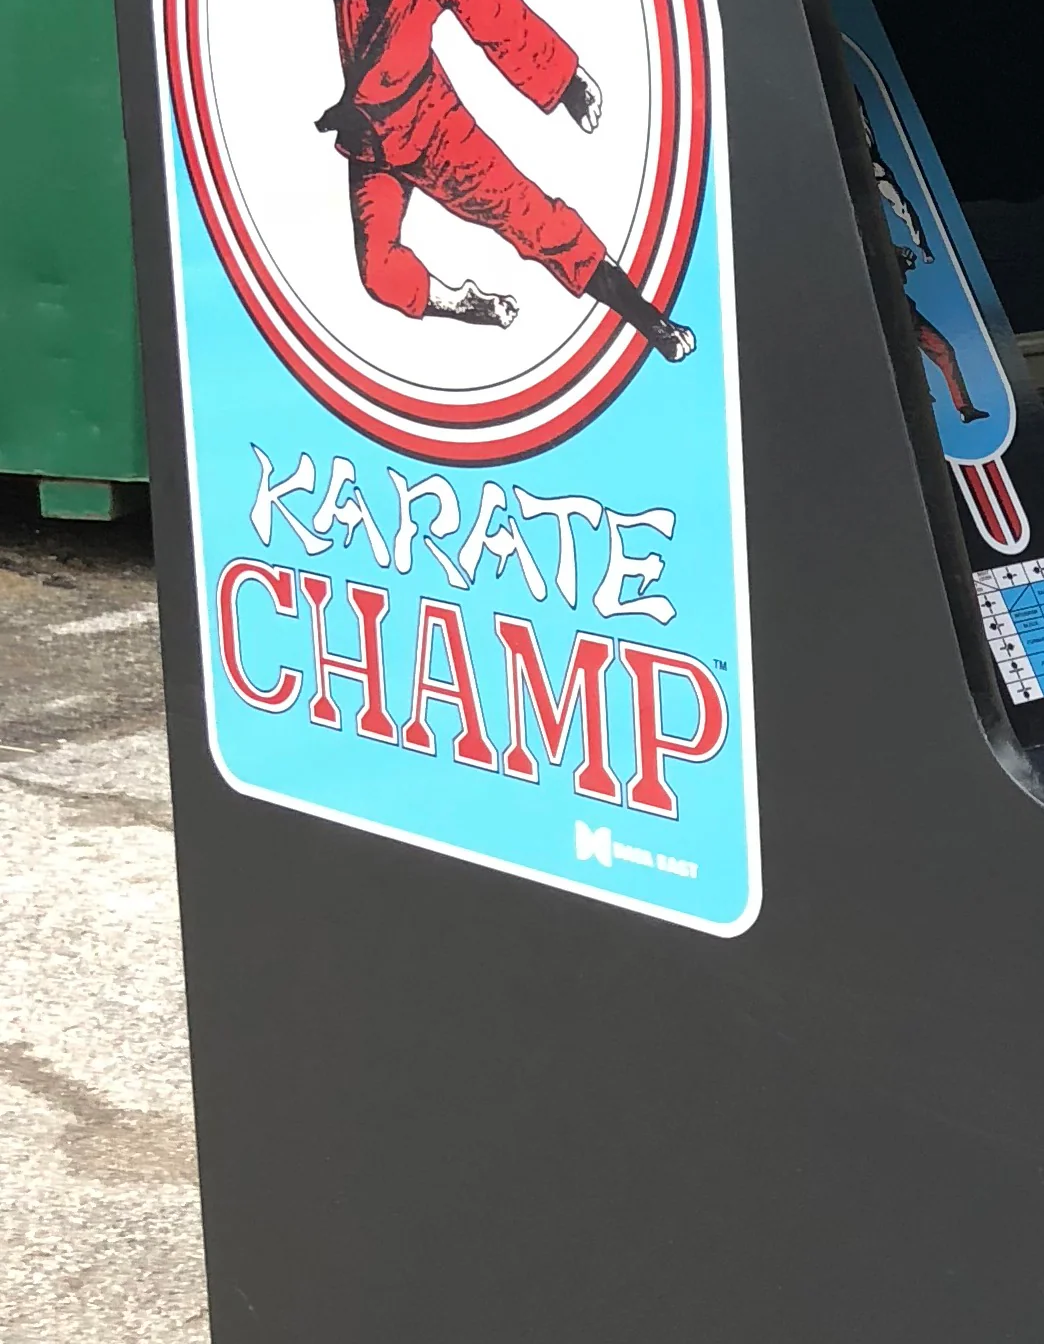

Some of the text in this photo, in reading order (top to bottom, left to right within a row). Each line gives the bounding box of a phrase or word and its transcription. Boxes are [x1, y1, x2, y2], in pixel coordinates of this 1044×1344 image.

[249, 442, 677, 626] KARATE
[217, 556, 729, 820] CHAMP
[656, 853, 698, 879] EAST
